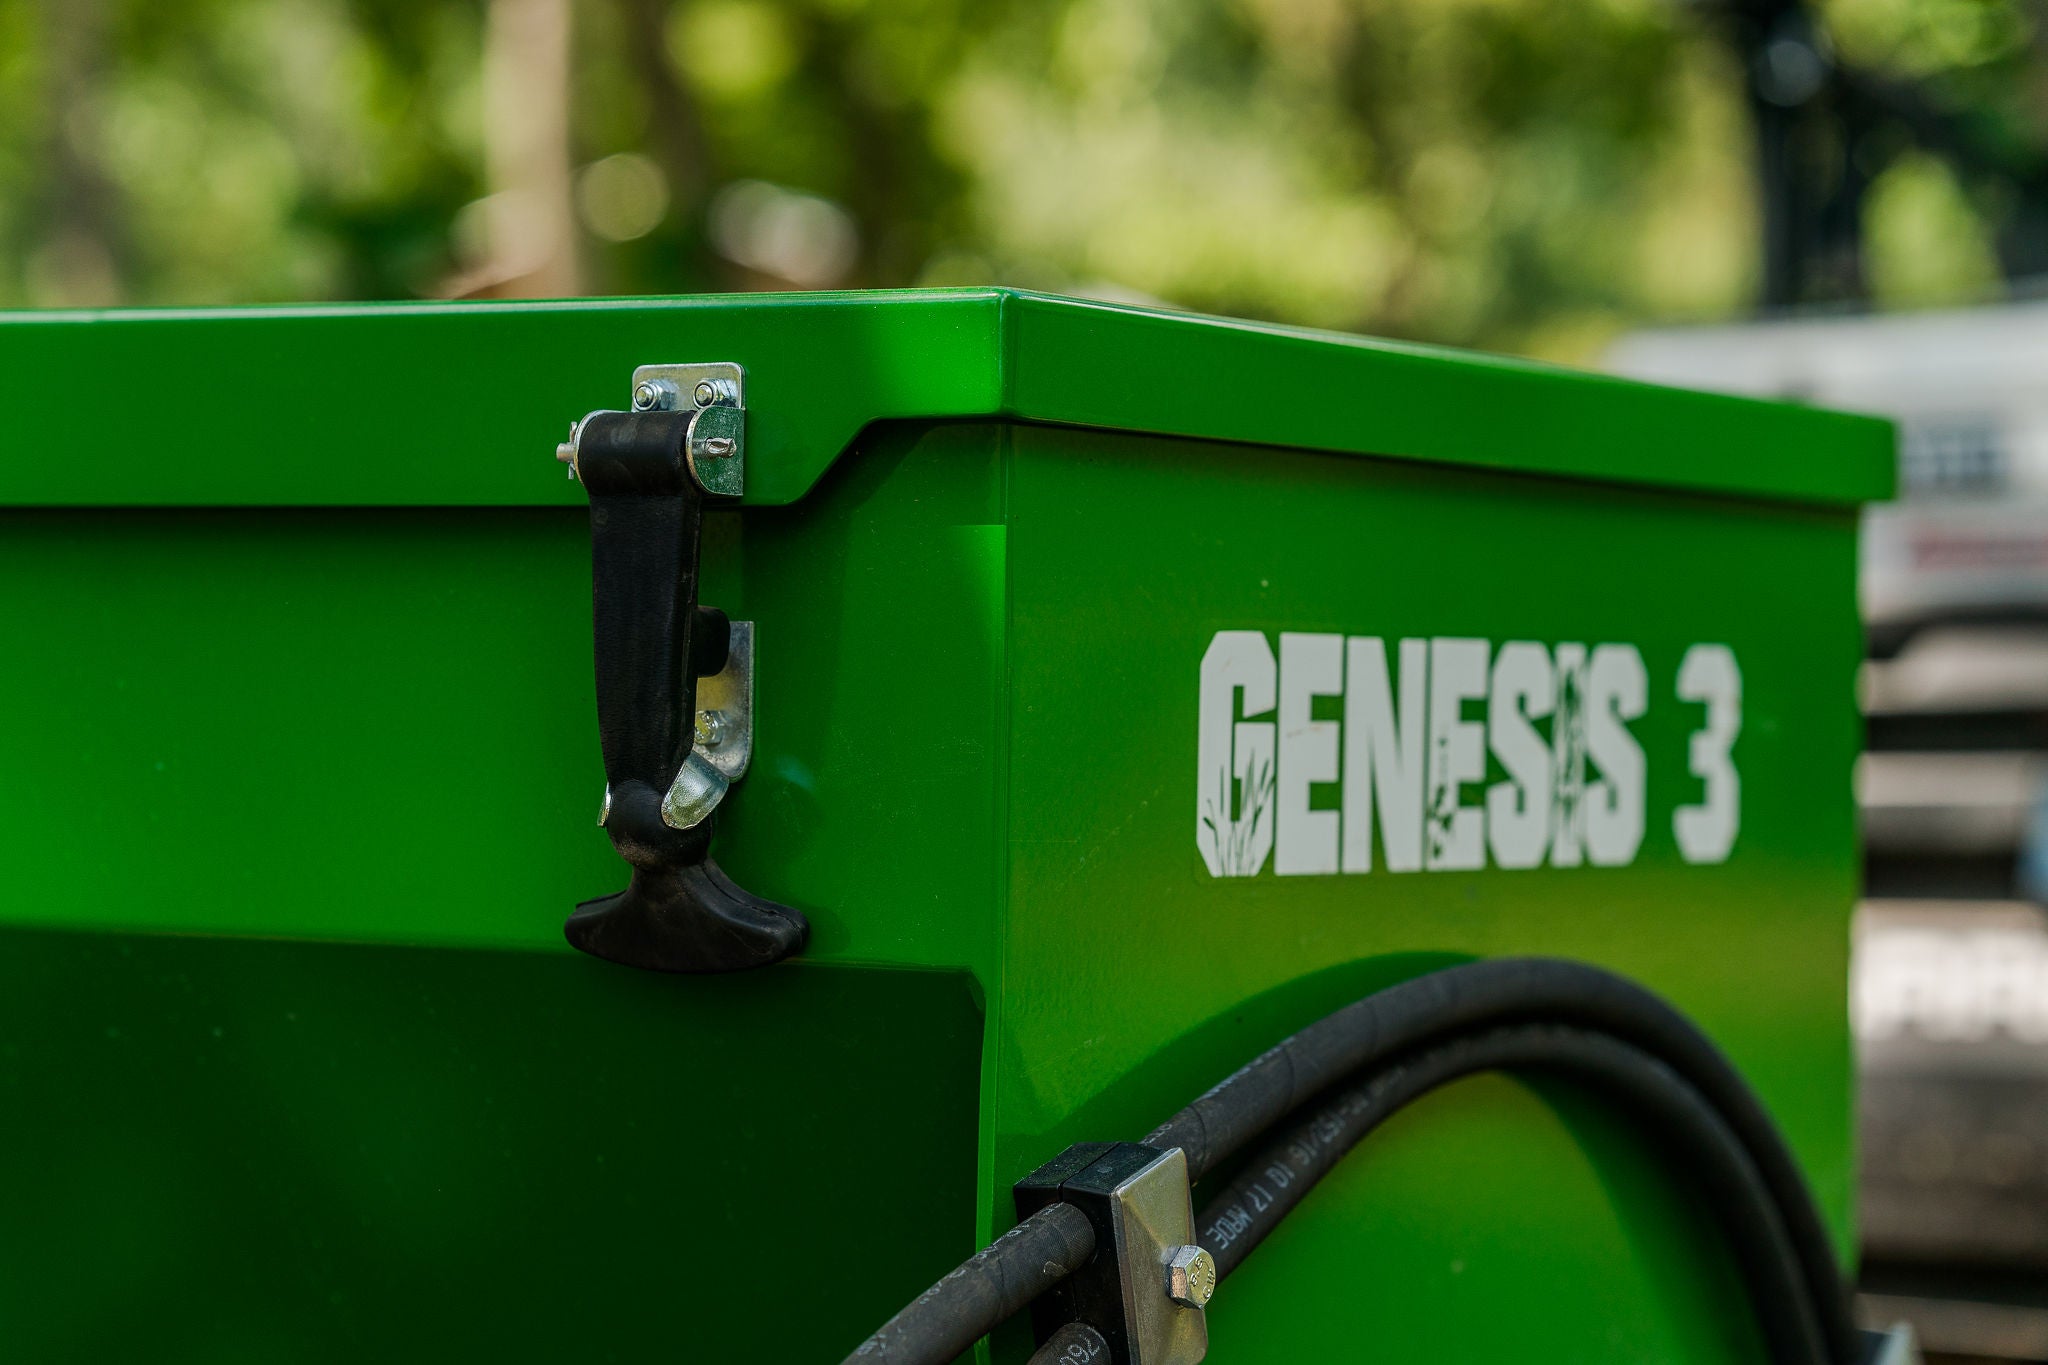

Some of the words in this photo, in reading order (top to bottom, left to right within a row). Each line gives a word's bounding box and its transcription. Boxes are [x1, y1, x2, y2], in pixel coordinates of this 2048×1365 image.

[1197, 630, 1648, 877] GENESIS
[1672, 643, 1742, 864] 3
[1246, 1184, 1273, 1212] 17
[1205, 1204, 1253, 1250] MADE
